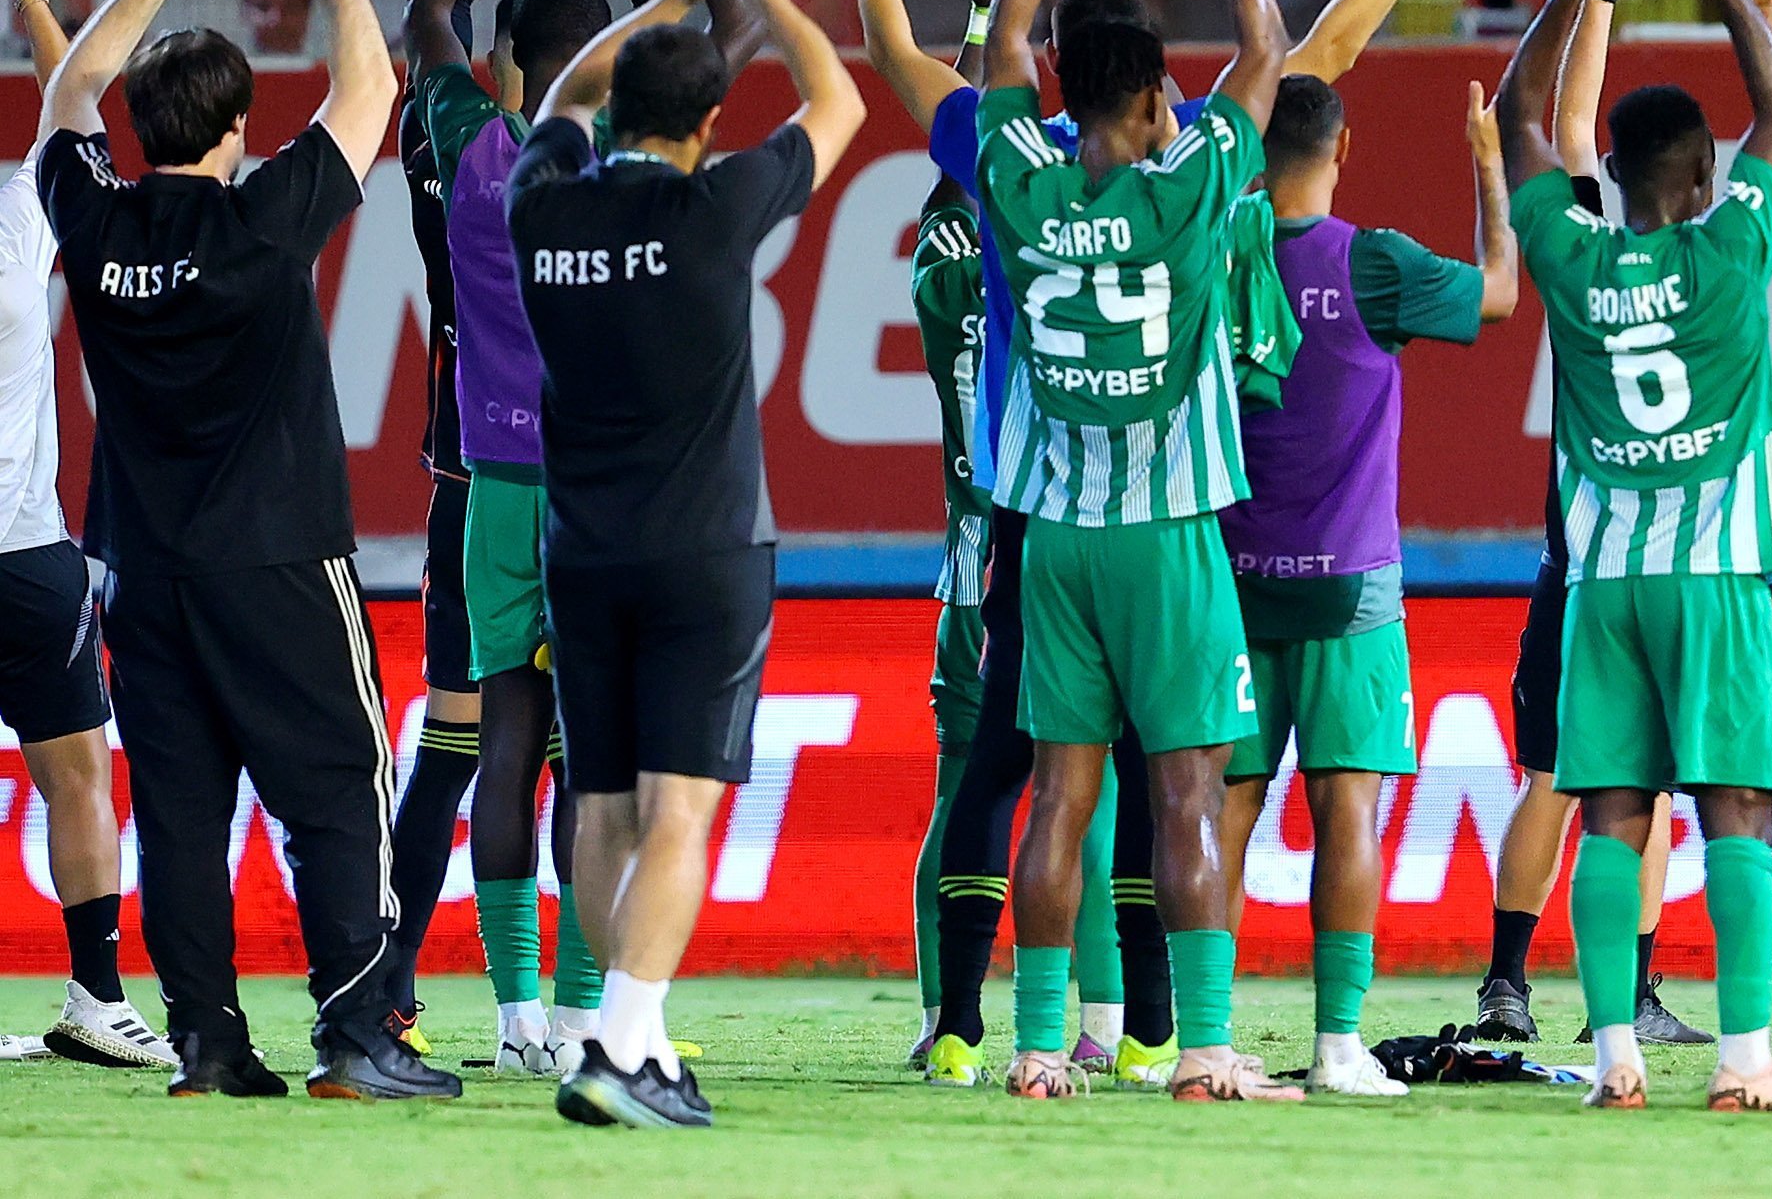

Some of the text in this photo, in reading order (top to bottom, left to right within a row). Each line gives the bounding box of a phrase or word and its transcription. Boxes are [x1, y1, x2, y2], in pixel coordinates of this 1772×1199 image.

[1038, 216, 1132, 257] SARFO
[100, 261, 164, 298] ARIS
[534, 240, 668, 285] ARIS FC
[1017, 245, 1172, 359] 24
[1300, 287, 1341, 320] FC
[1587, 273, 1689, 324] BOAKYE
[1603, 321, 1692, 434] 6
